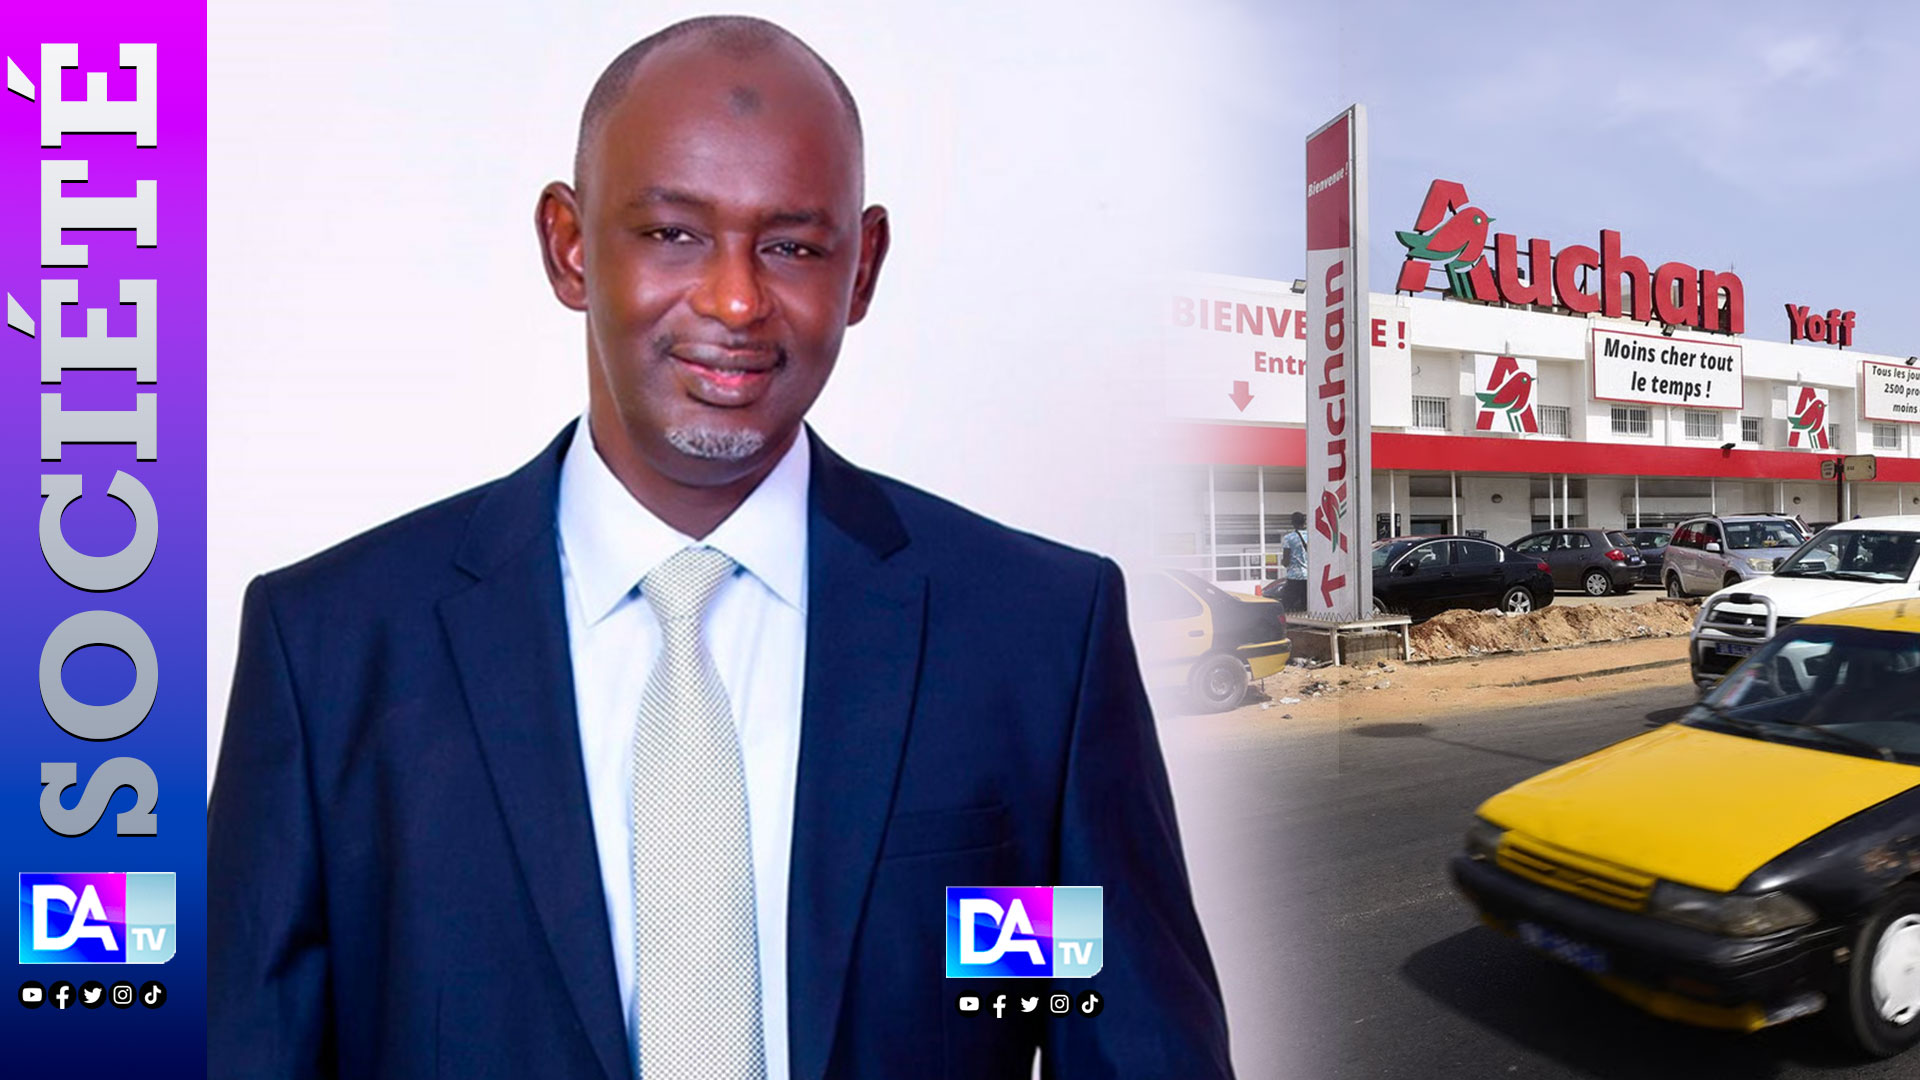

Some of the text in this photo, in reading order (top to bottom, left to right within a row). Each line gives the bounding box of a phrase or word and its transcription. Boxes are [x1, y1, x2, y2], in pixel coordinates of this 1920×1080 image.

[1308, 167, 1345, 198] Bienvenue
[1395, 178, 1745, 334] Auchan
[1784, 303, 1856, 347] Yoff
[1603, 337, 1734, 372] Moins cher tout
[1631, 370, 1647, 391] le
[1651, 376, 1702, 402] temps
[1872, 365, 1892, 378] Tous
[1893, 367, 1906, 379] les
[1884, 382, 1905, 395] 2500
[1315, 260, 1348, 554] Auchan
[1892, 402, 1918, 414] moins
